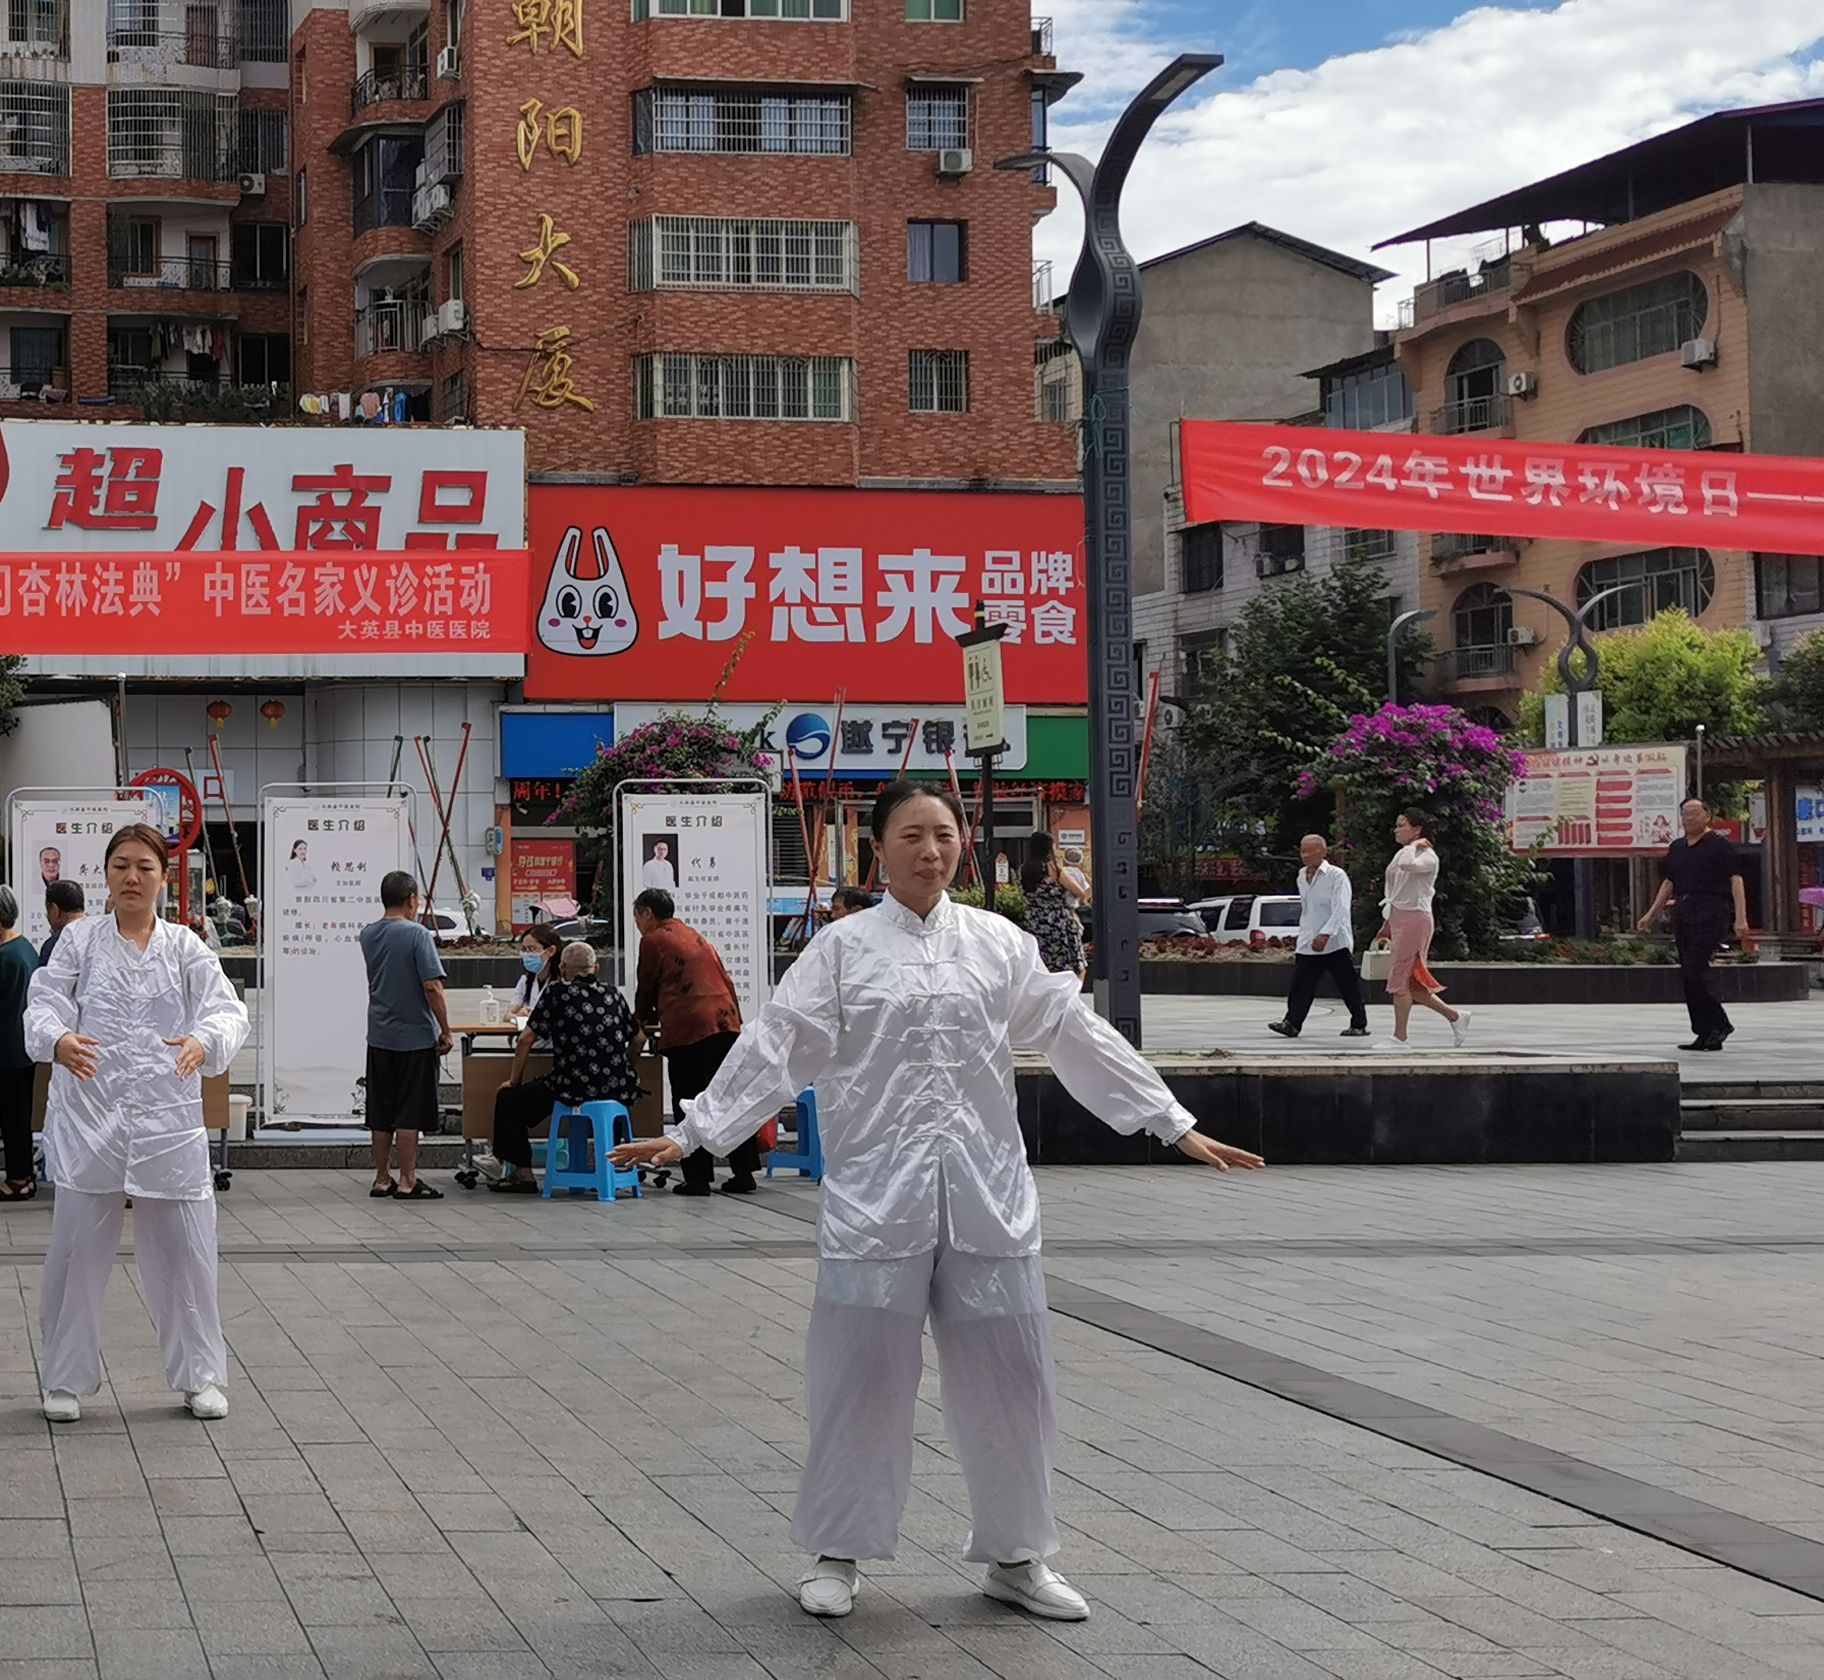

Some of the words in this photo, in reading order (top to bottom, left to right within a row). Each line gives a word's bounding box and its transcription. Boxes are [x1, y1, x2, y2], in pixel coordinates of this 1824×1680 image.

[506, 0, 593, 411] 朝阳大厦
[204, 561, 491, 617] 中医名家义诊活动
[981, 550, 1075, 595] 品牌
[657, 544, 970, 644] 好想来
[338, 620, 491, 640] 大英县中医医院
[982, 599, 1077, 646] 零食
[841, 719, 969, 755] 遂宁银
[56, 822, 114, 835] 医生介绍
[307, 819, 366, 831] 医生介绍
[665, 815, 723, 828] 医生介绍
